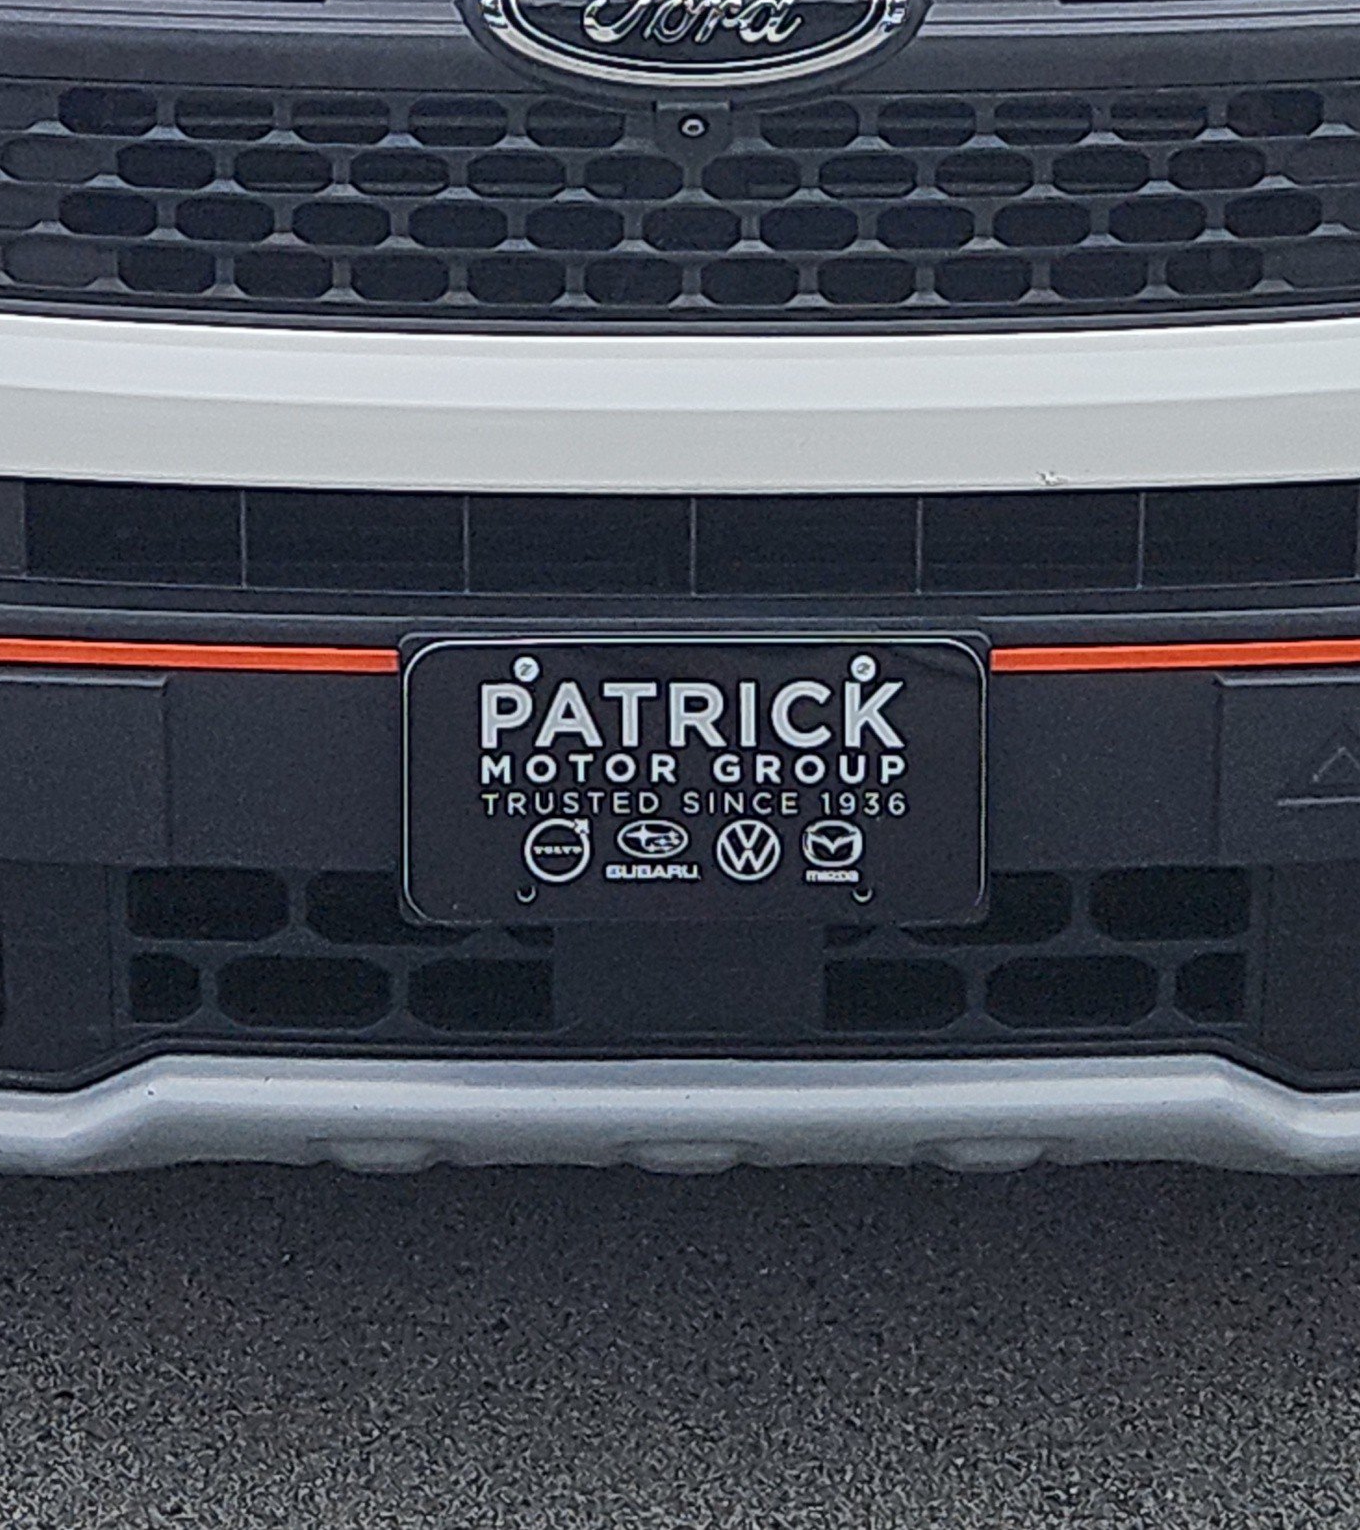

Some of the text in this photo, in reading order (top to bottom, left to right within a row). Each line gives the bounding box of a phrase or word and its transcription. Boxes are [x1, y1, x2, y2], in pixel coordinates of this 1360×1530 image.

[480, 680, 906, 749] PATRICK
[481, 753, 906, 785] MOTOR GROUP
[482, 792, 906, 816] TRUSTED SINCE 1936
[533, 845, 583, 855] VOLVO
[605, 864, 698, 879] SUBARU
